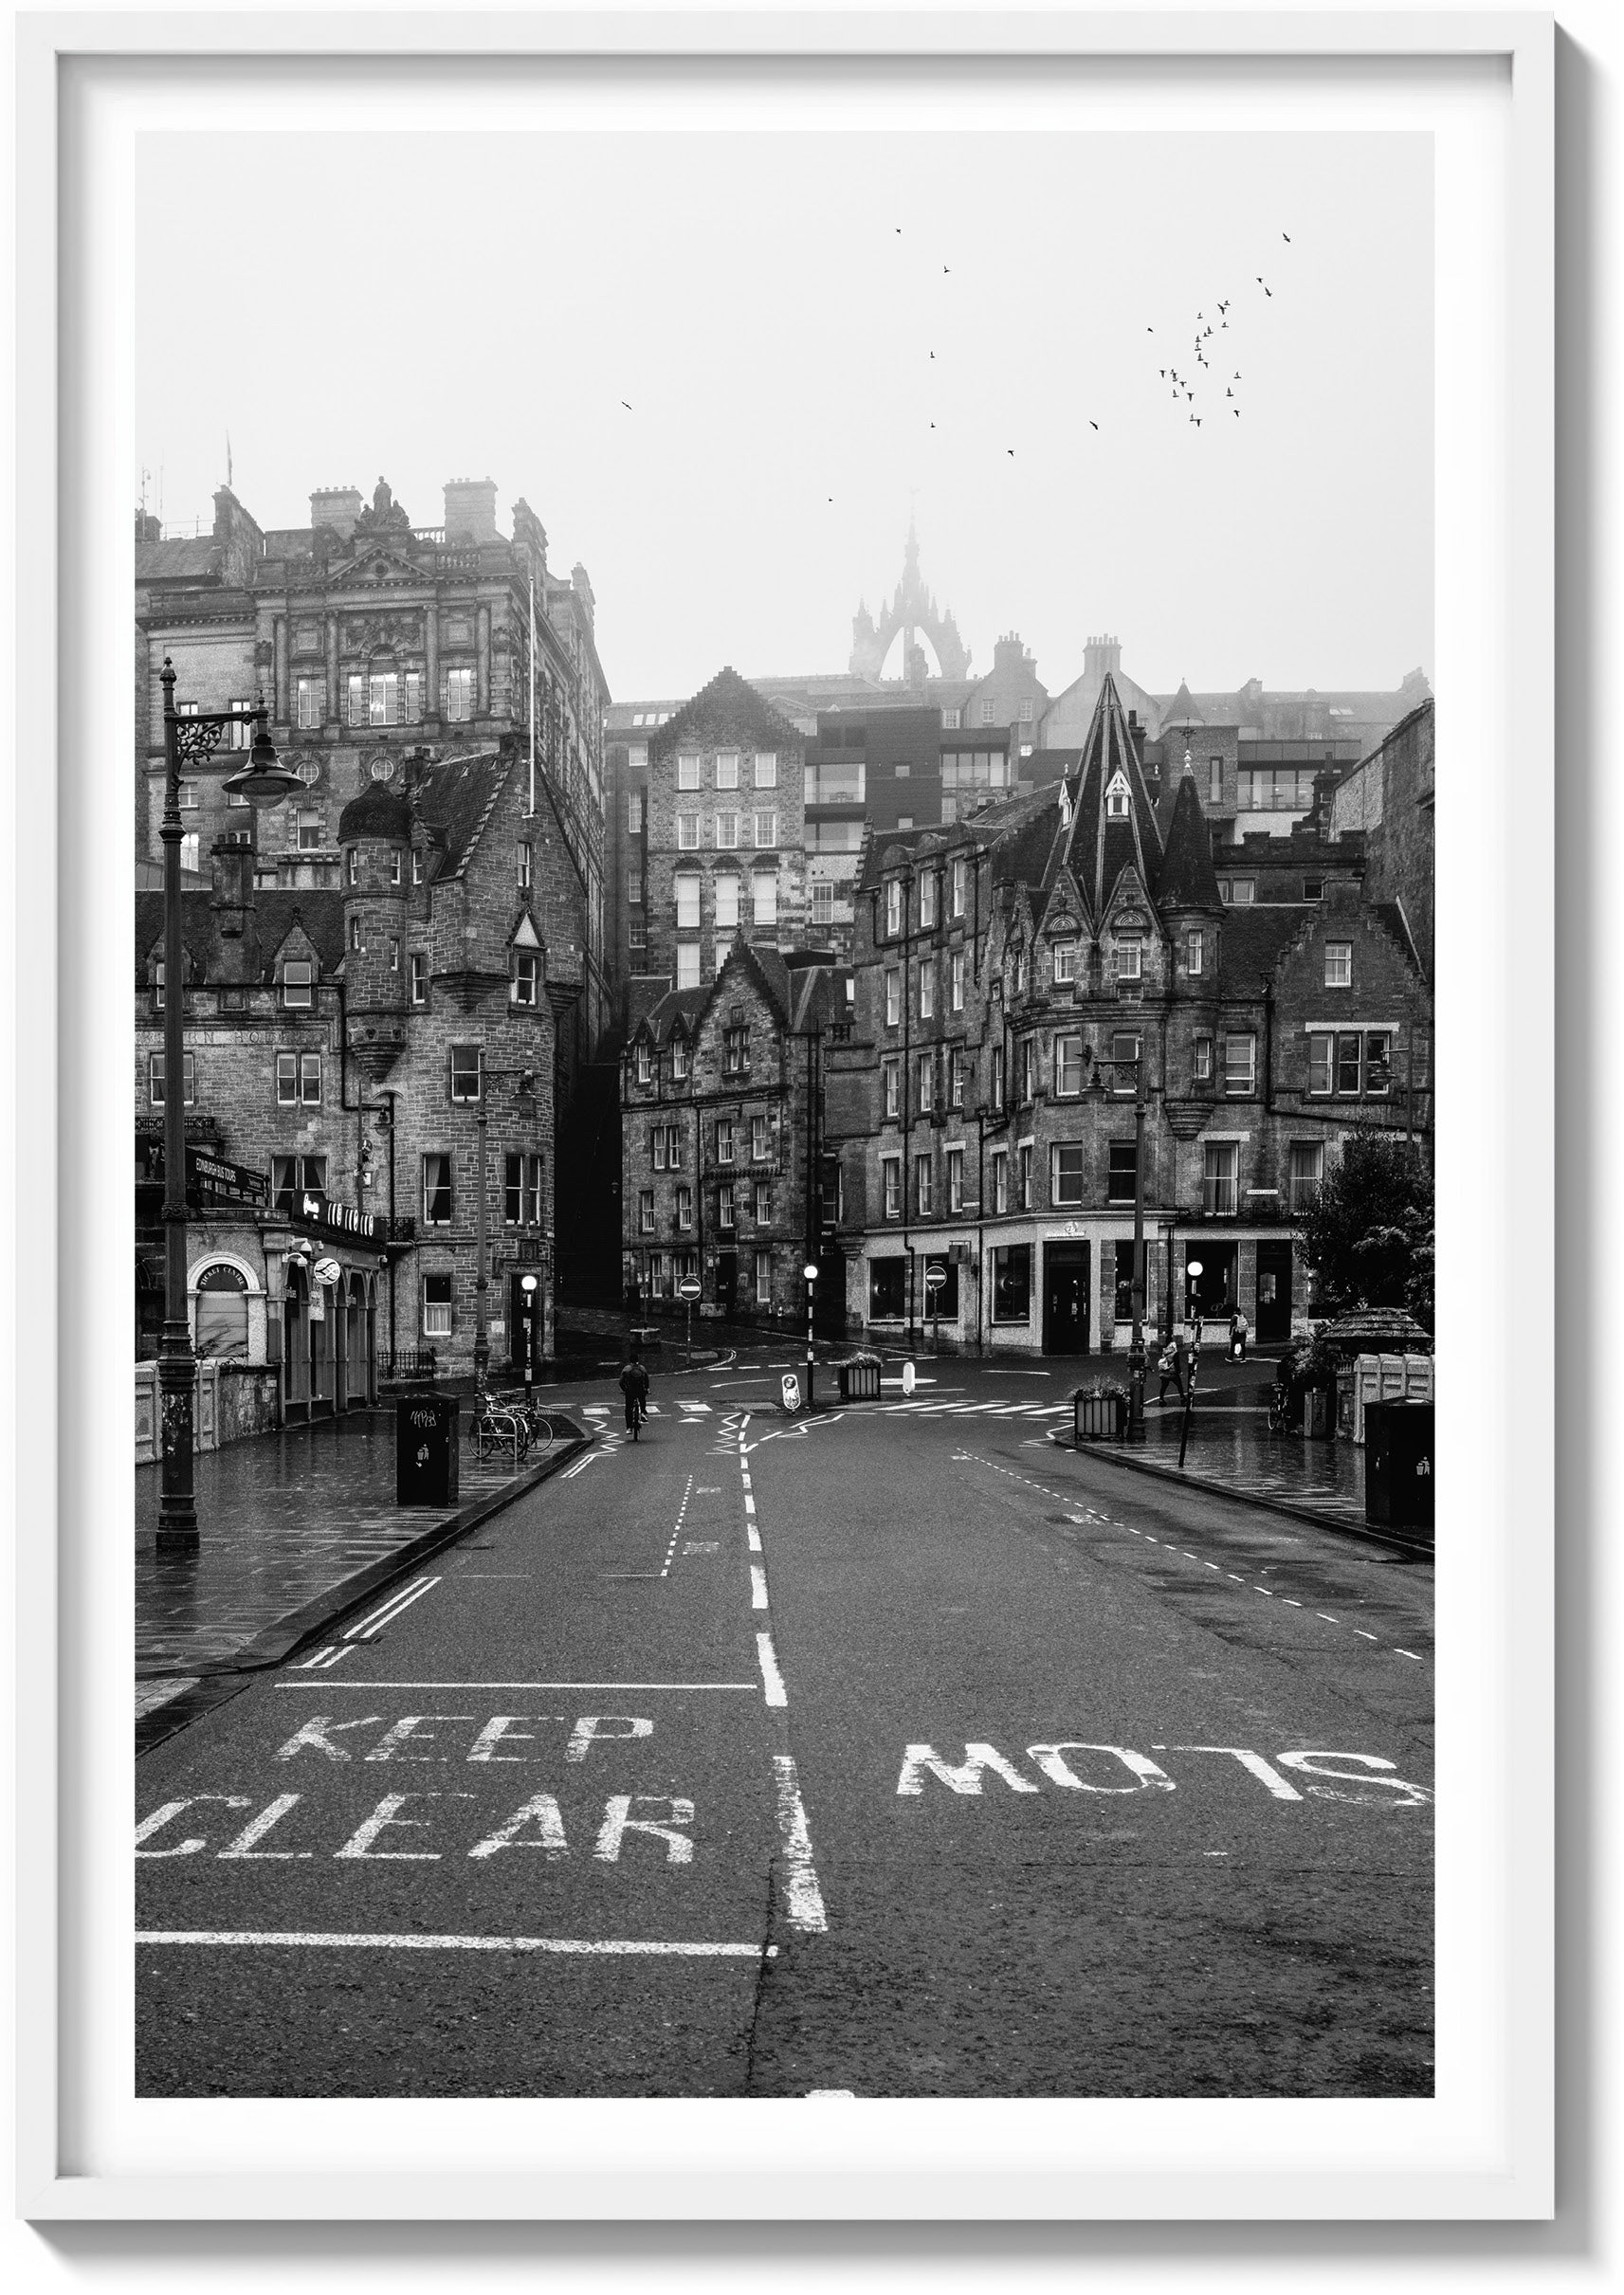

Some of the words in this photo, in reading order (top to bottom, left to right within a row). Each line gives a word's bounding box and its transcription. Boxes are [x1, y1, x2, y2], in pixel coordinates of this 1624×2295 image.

[199, 1266, 220, 1285] TICKET
[271, 1717, 654, 1762] KEEP
[896, 1743, 1434, 1807] SLOW
[135, 1794, 695, 1864] CLEAR
